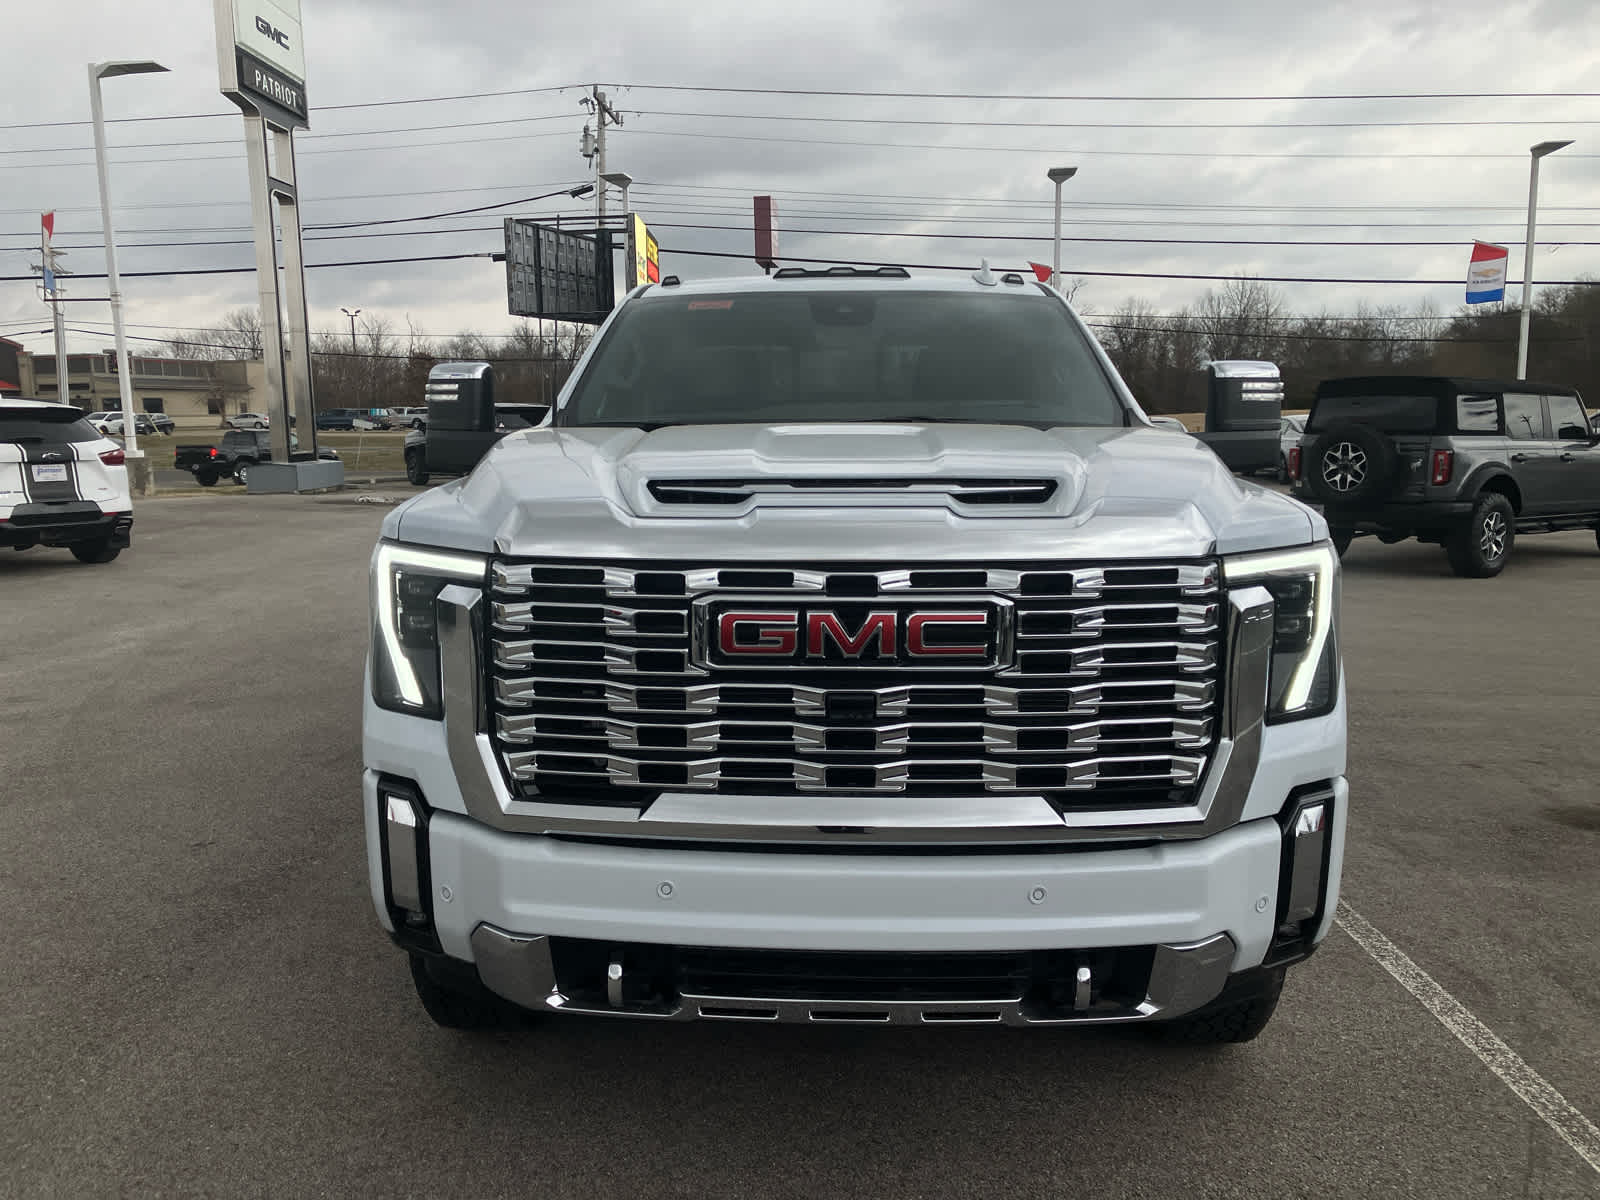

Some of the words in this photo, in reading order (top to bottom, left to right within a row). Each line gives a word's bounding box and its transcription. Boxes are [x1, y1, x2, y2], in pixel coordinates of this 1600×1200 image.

[255, 15, 290, 51] GMC
[254, 69, 297, 108] PATRIOT
[718, 610, 989, 658] GMC
